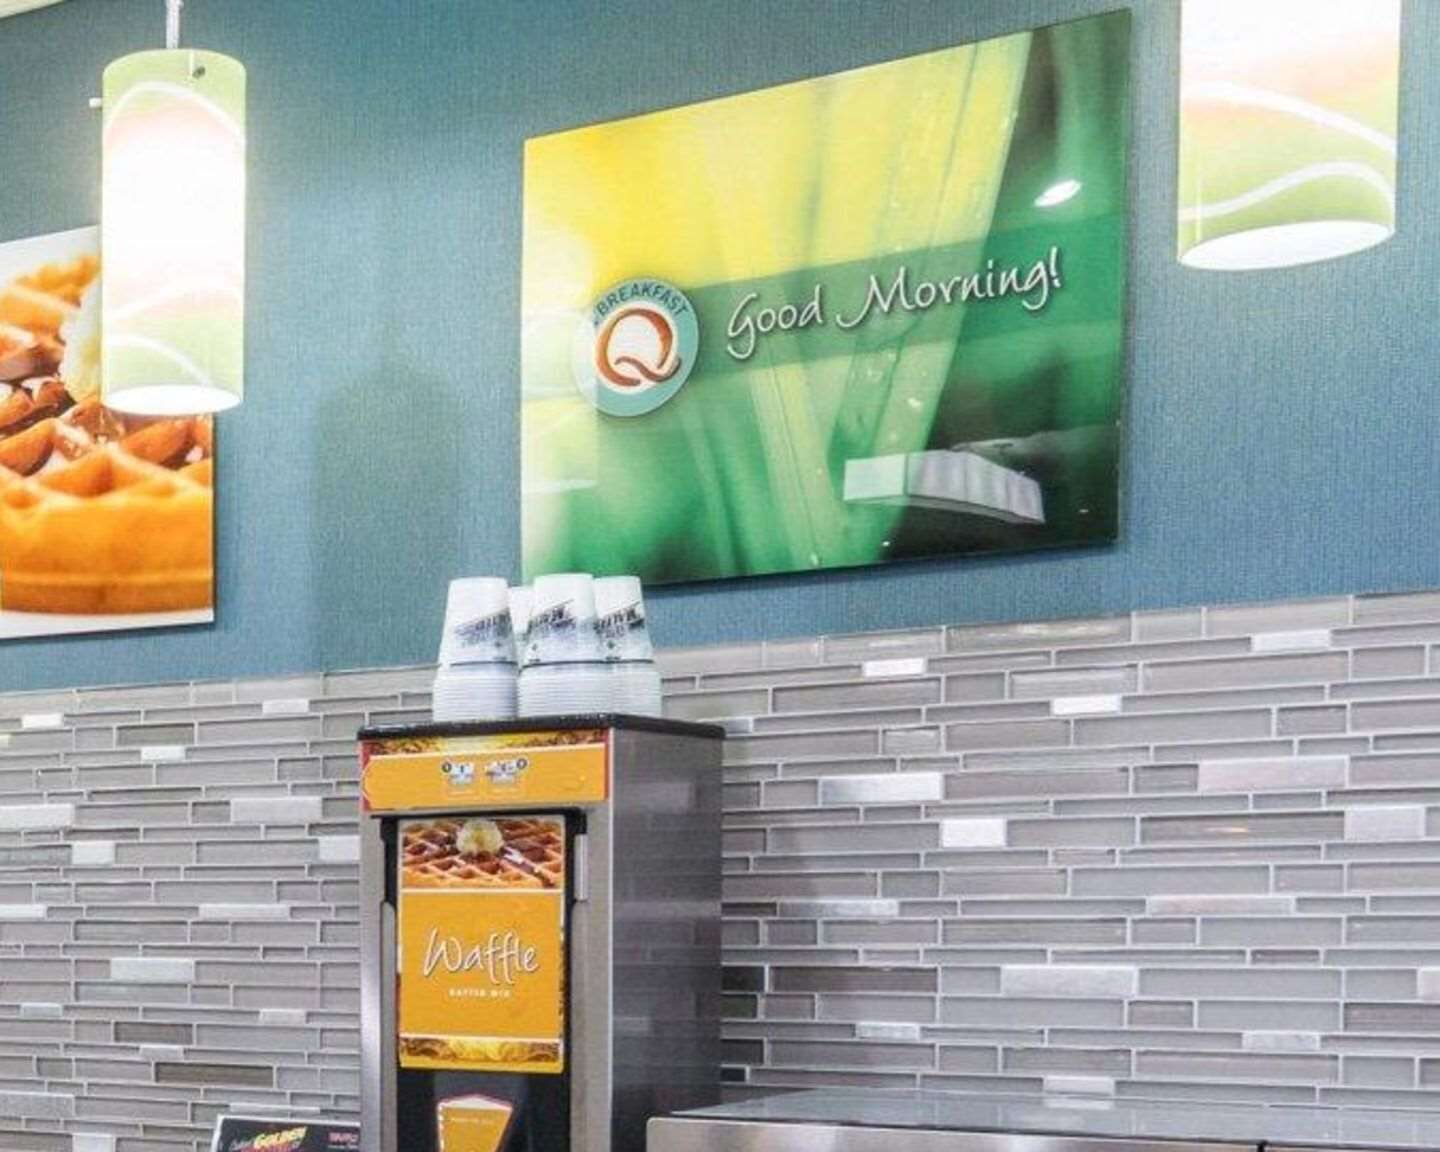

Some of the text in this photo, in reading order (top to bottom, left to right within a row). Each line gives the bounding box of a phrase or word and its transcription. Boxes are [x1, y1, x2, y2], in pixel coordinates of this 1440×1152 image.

[596, 283, 689, 317] BREAKFAST
[727, 246, 1062, 360] Good Morning!
[595, 308, 682, 386] Q
[423, 927, 540, 986] Waffle
